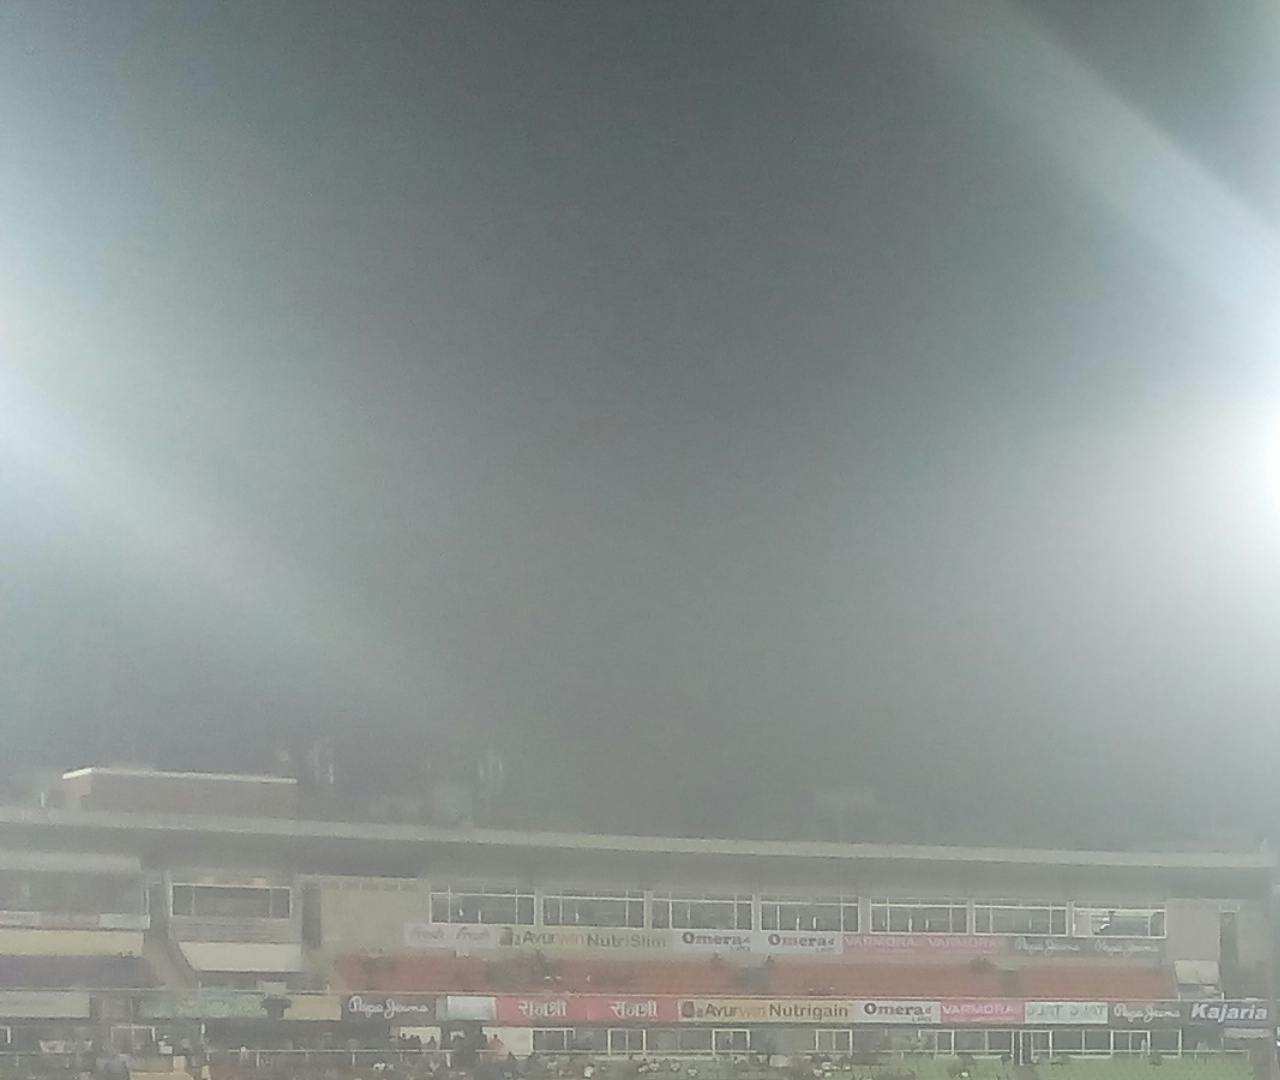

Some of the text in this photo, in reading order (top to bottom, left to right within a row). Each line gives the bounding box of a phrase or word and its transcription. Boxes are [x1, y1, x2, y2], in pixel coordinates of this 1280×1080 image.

[587, 930, 666, 948] NutriSlim
[769, 1002, 848, 1020] Nutrigain
[864, 1002, 923, 1015] Omera
[1191, 1003, 1267, 1023] Kajaria
